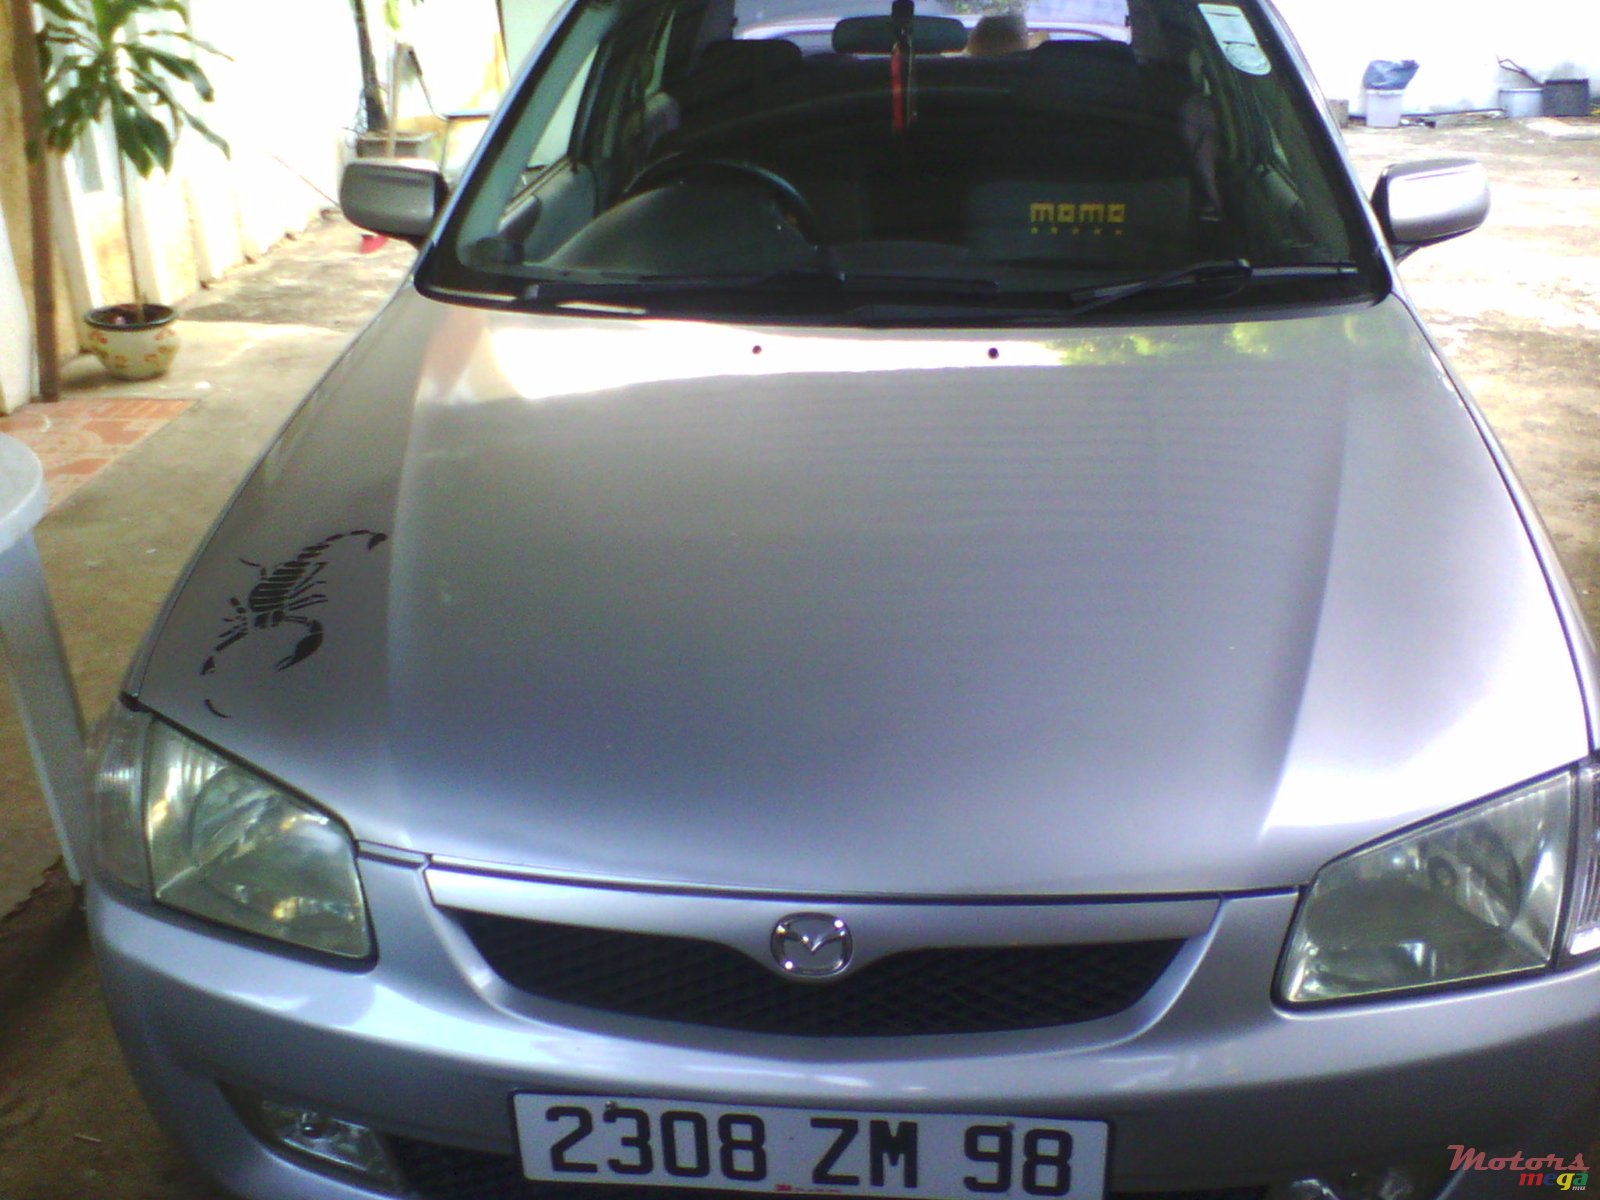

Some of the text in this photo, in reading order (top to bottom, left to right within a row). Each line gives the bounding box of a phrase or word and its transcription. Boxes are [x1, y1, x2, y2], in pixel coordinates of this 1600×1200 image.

[1030, 203, 1125, 223] momo
[545, 1106, 1074, 1197] 2308 ZM 98
